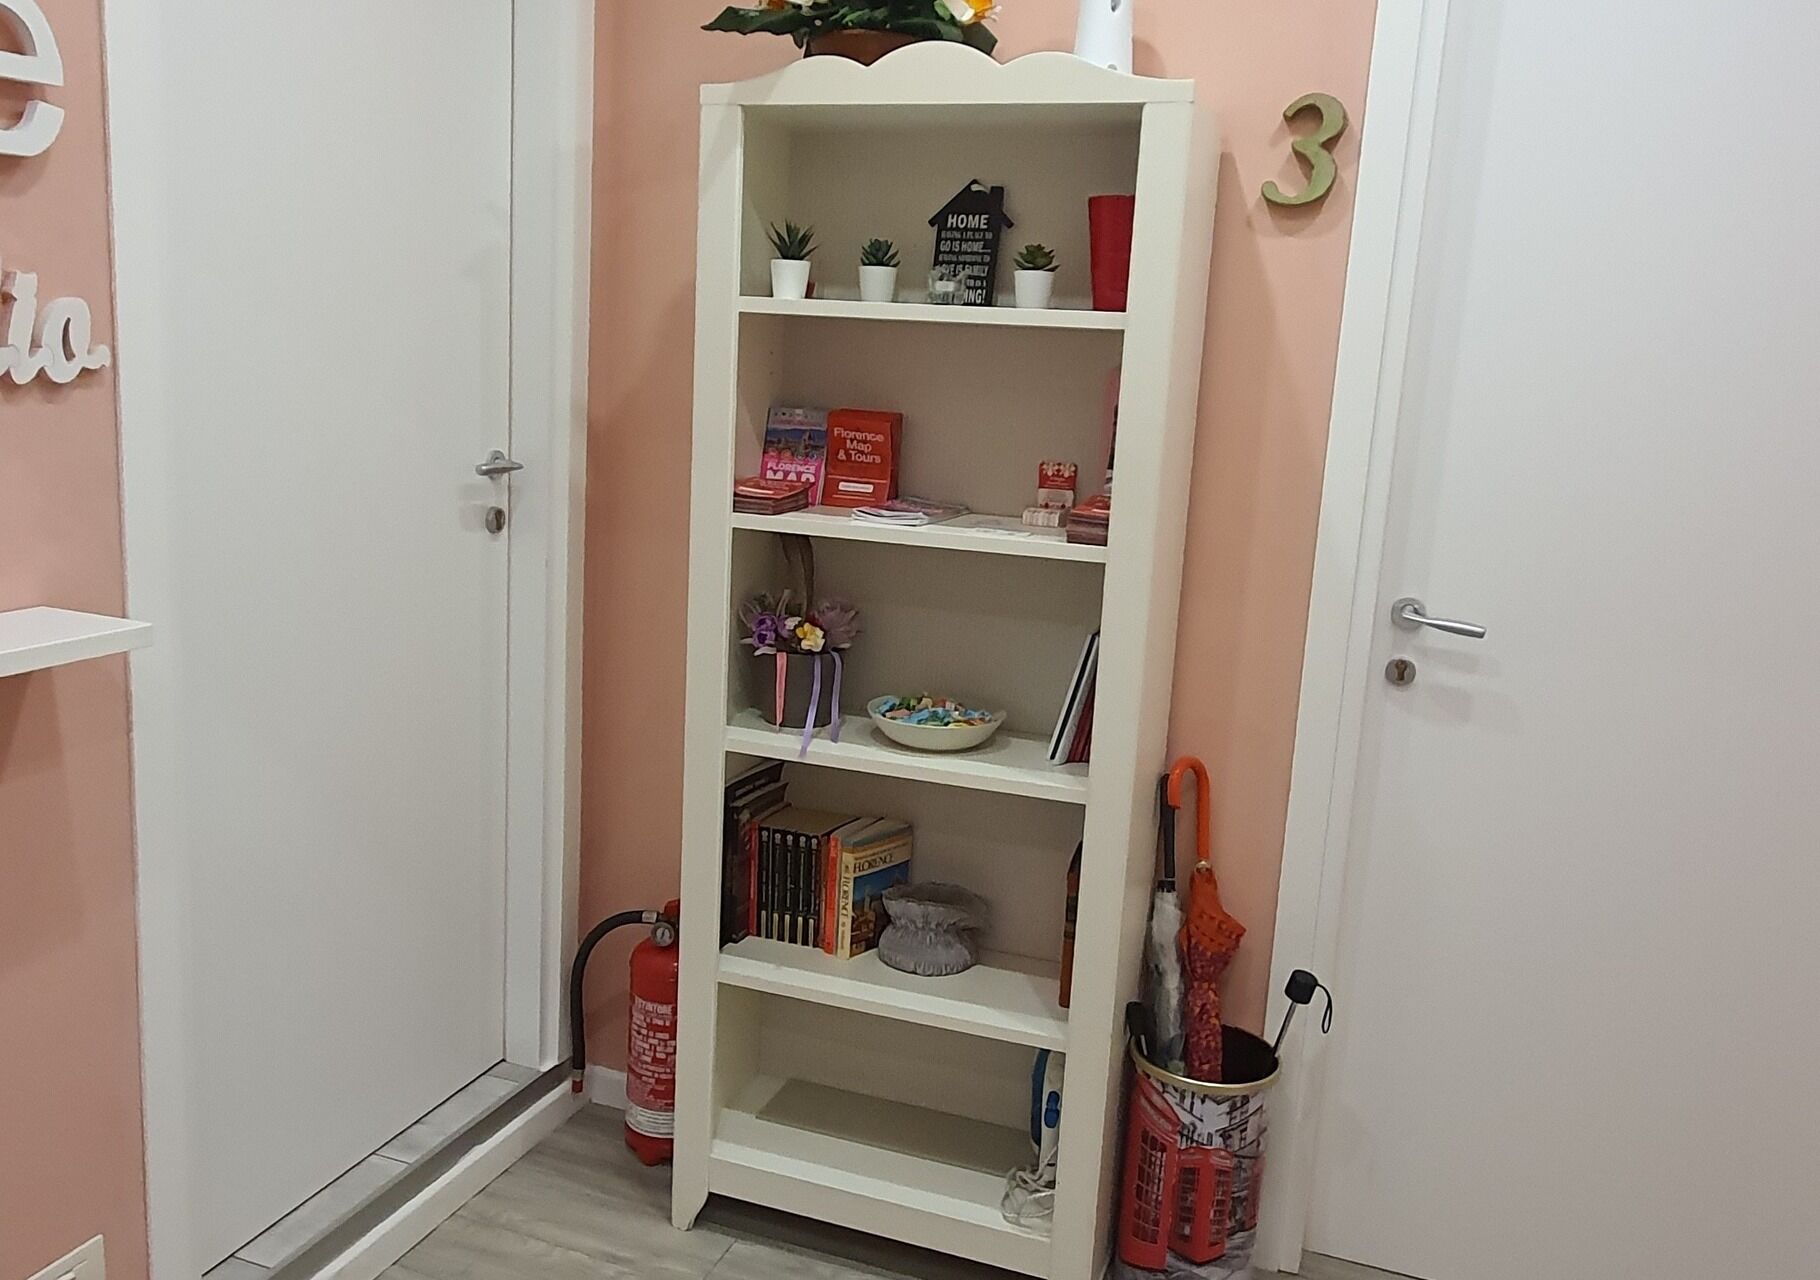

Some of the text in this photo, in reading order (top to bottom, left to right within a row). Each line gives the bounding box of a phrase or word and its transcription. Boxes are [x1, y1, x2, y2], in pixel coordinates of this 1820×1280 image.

[1261, 92, 1348, 206] 3
[947, 214, 989, 229] HOME
[940, 240, 951, 252] GO
[952, 240, 960, 252] IS
[833, 426, 885, 442] Florence
[846, 440, 872, 453] Map
[837, 449, 881, 464] & Tours
[767, 462, 816, 473] FLORENCE
